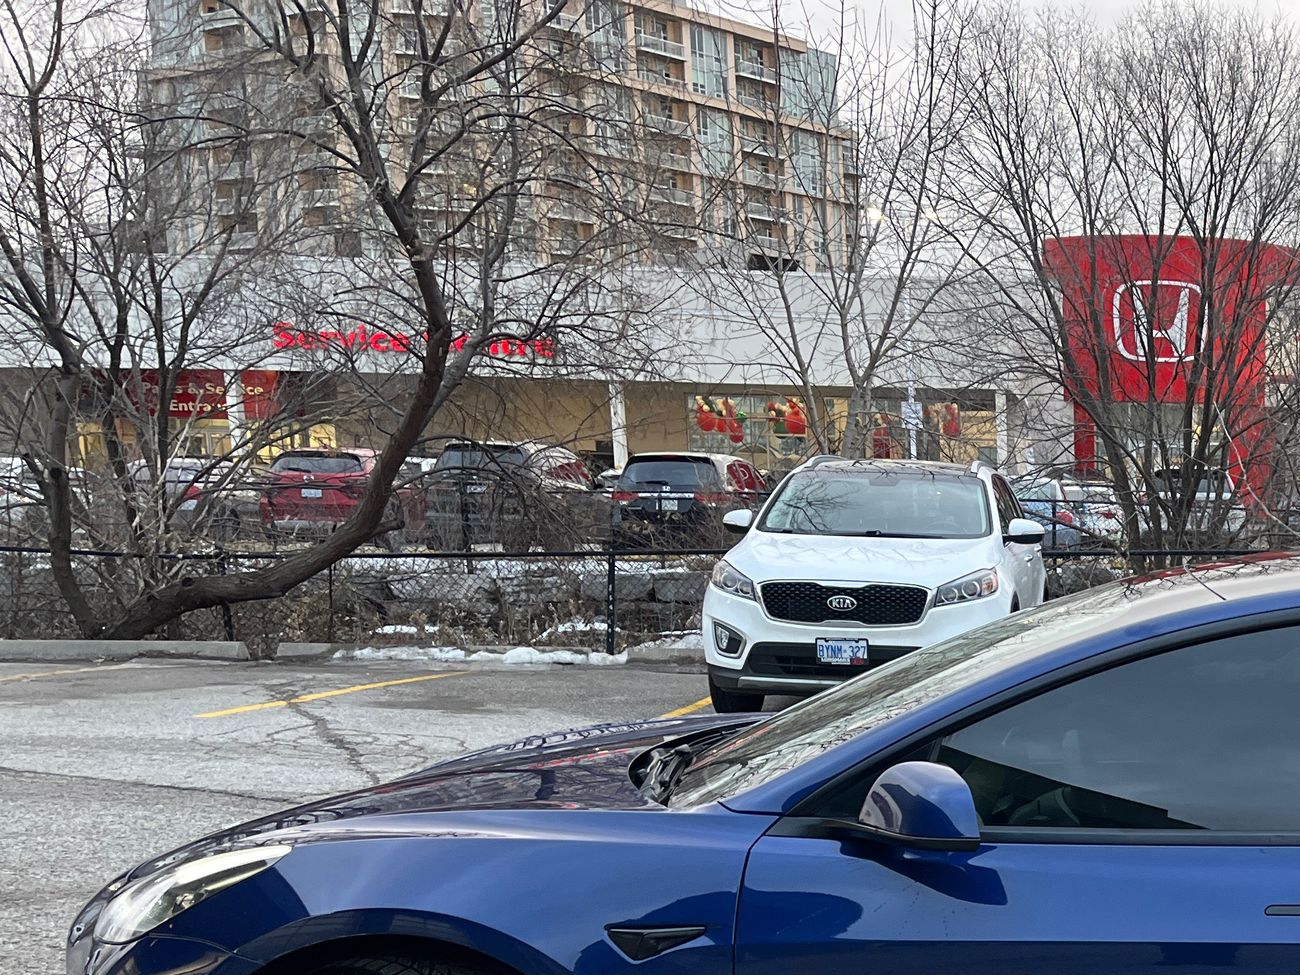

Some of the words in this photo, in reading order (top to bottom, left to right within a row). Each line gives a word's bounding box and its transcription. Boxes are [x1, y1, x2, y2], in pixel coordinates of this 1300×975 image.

[273, 321, 411, 352] Service
[423, 328, 556, 358] etre
[141, 381, 183, 394] Pas
[831, 598, 852, 608] KIA
